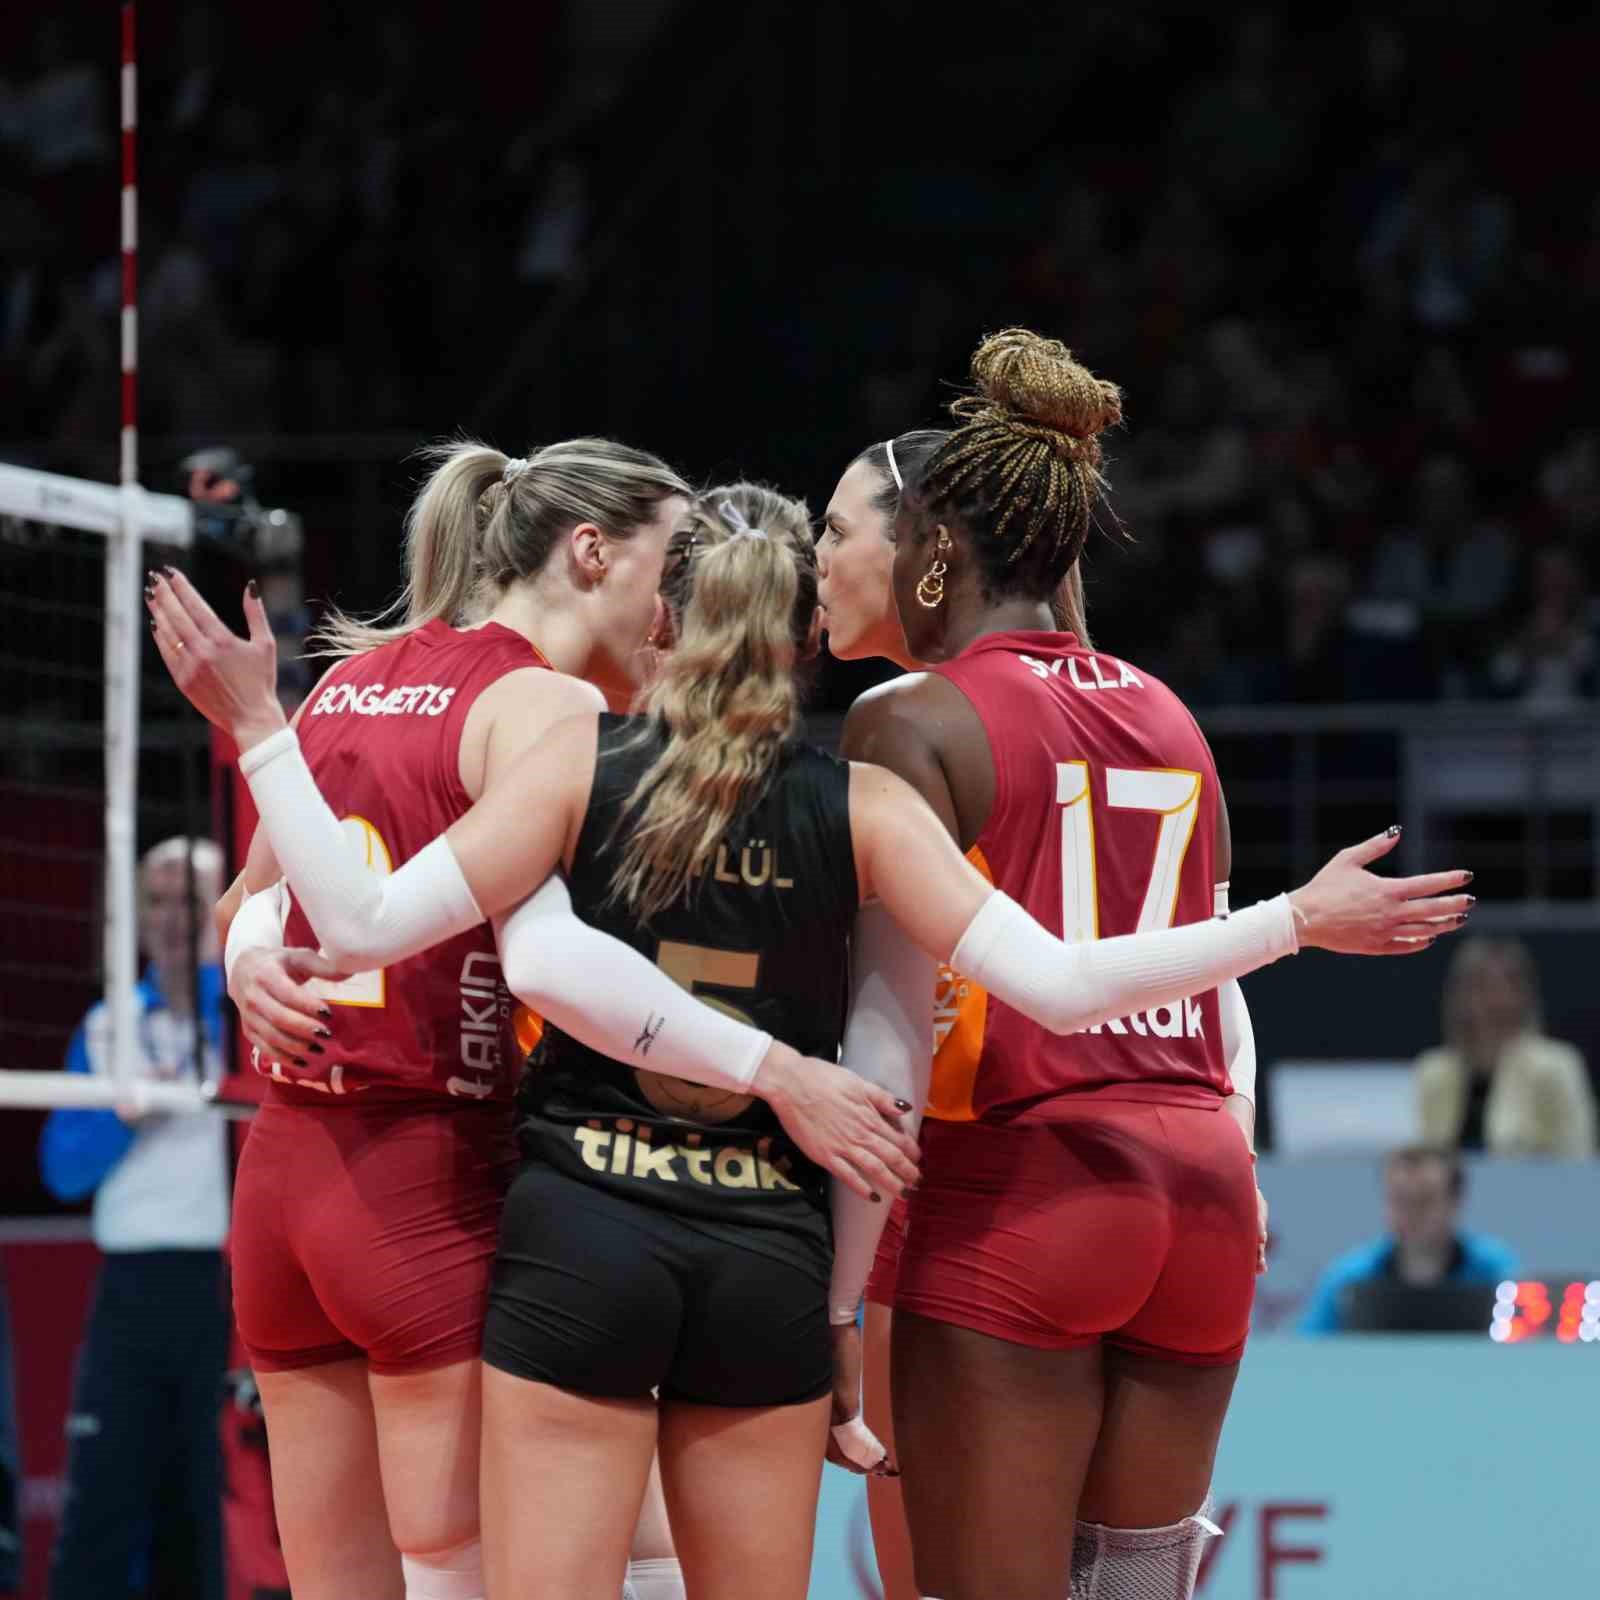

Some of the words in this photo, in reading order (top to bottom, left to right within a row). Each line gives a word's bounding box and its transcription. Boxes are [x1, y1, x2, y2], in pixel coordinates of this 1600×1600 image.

[1019, 655, 1144, 690] SYLLA
[311, 683, 456, 716] BONGAERTS
[1055, 760, 1202, 941] 17
[574, 1118, 802, 1190] tiktak
